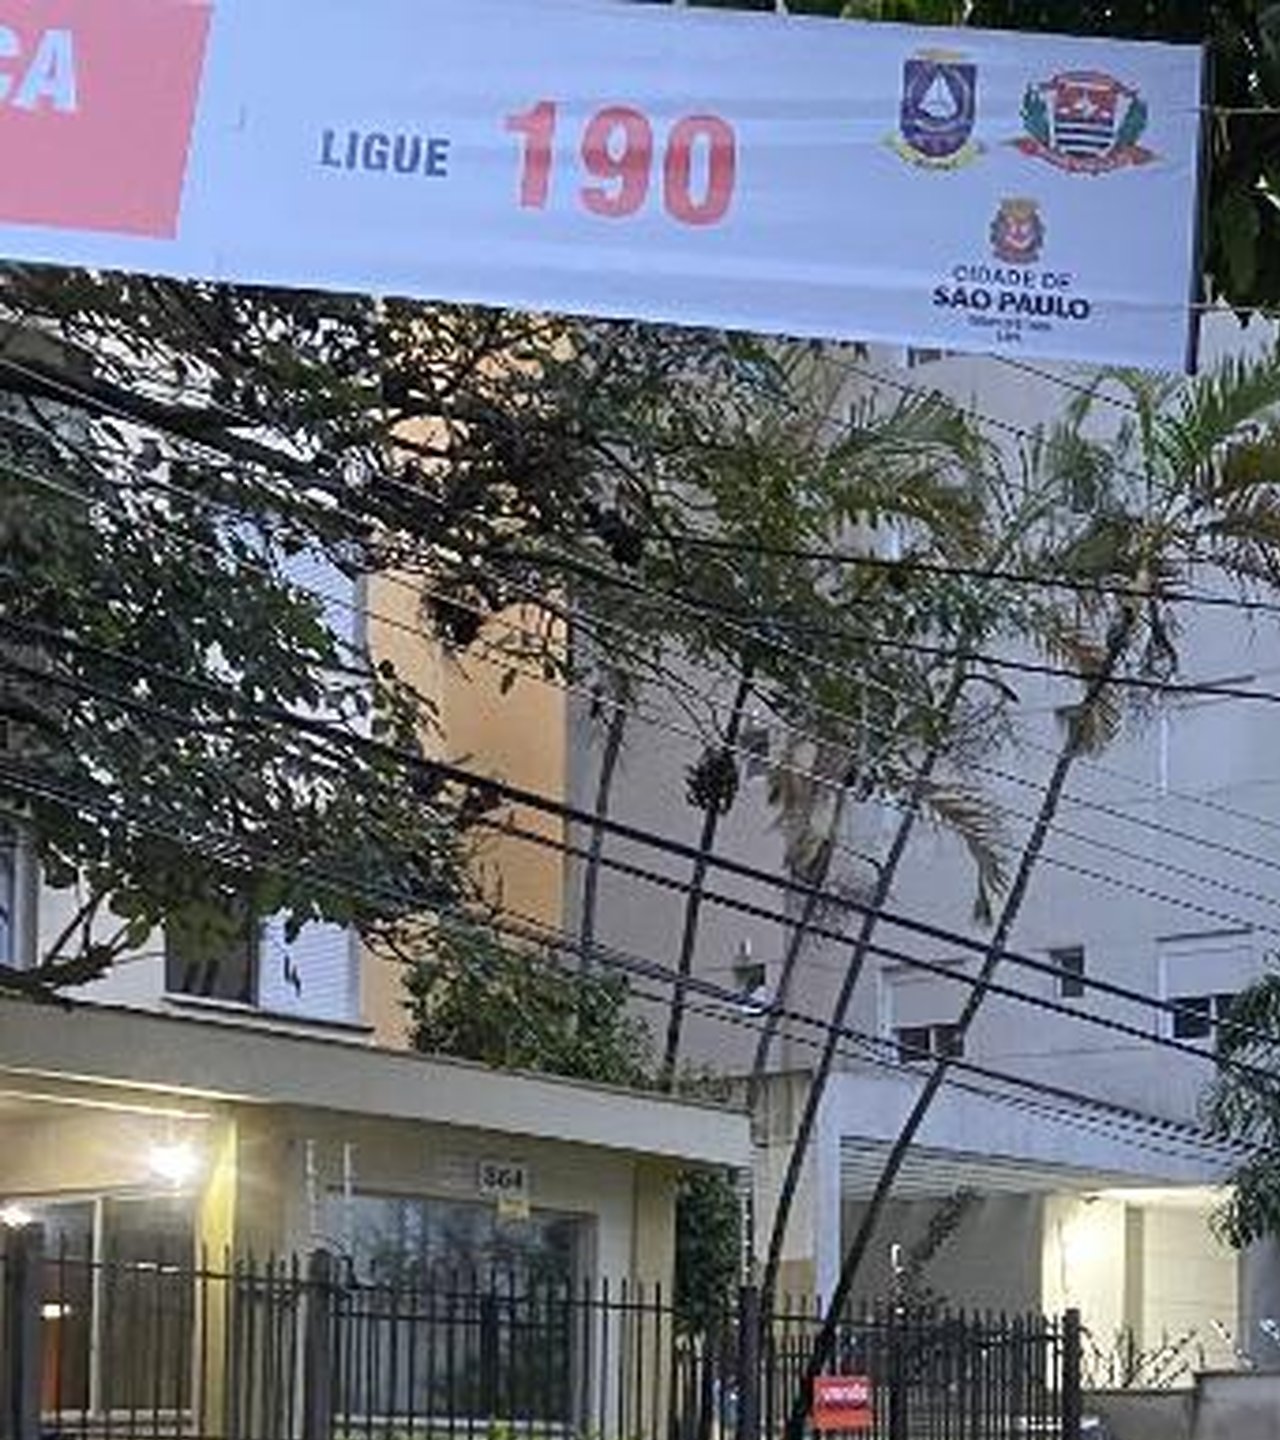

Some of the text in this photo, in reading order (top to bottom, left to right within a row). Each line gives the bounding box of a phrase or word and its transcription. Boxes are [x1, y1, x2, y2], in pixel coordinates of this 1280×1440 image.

[321, 130, 450, 177] LIGUE
[506, 101, 736, 225] 190
[953, 265, 1070, 290] CIDADE DE
[998, 291, 1091, 320] PAULO
